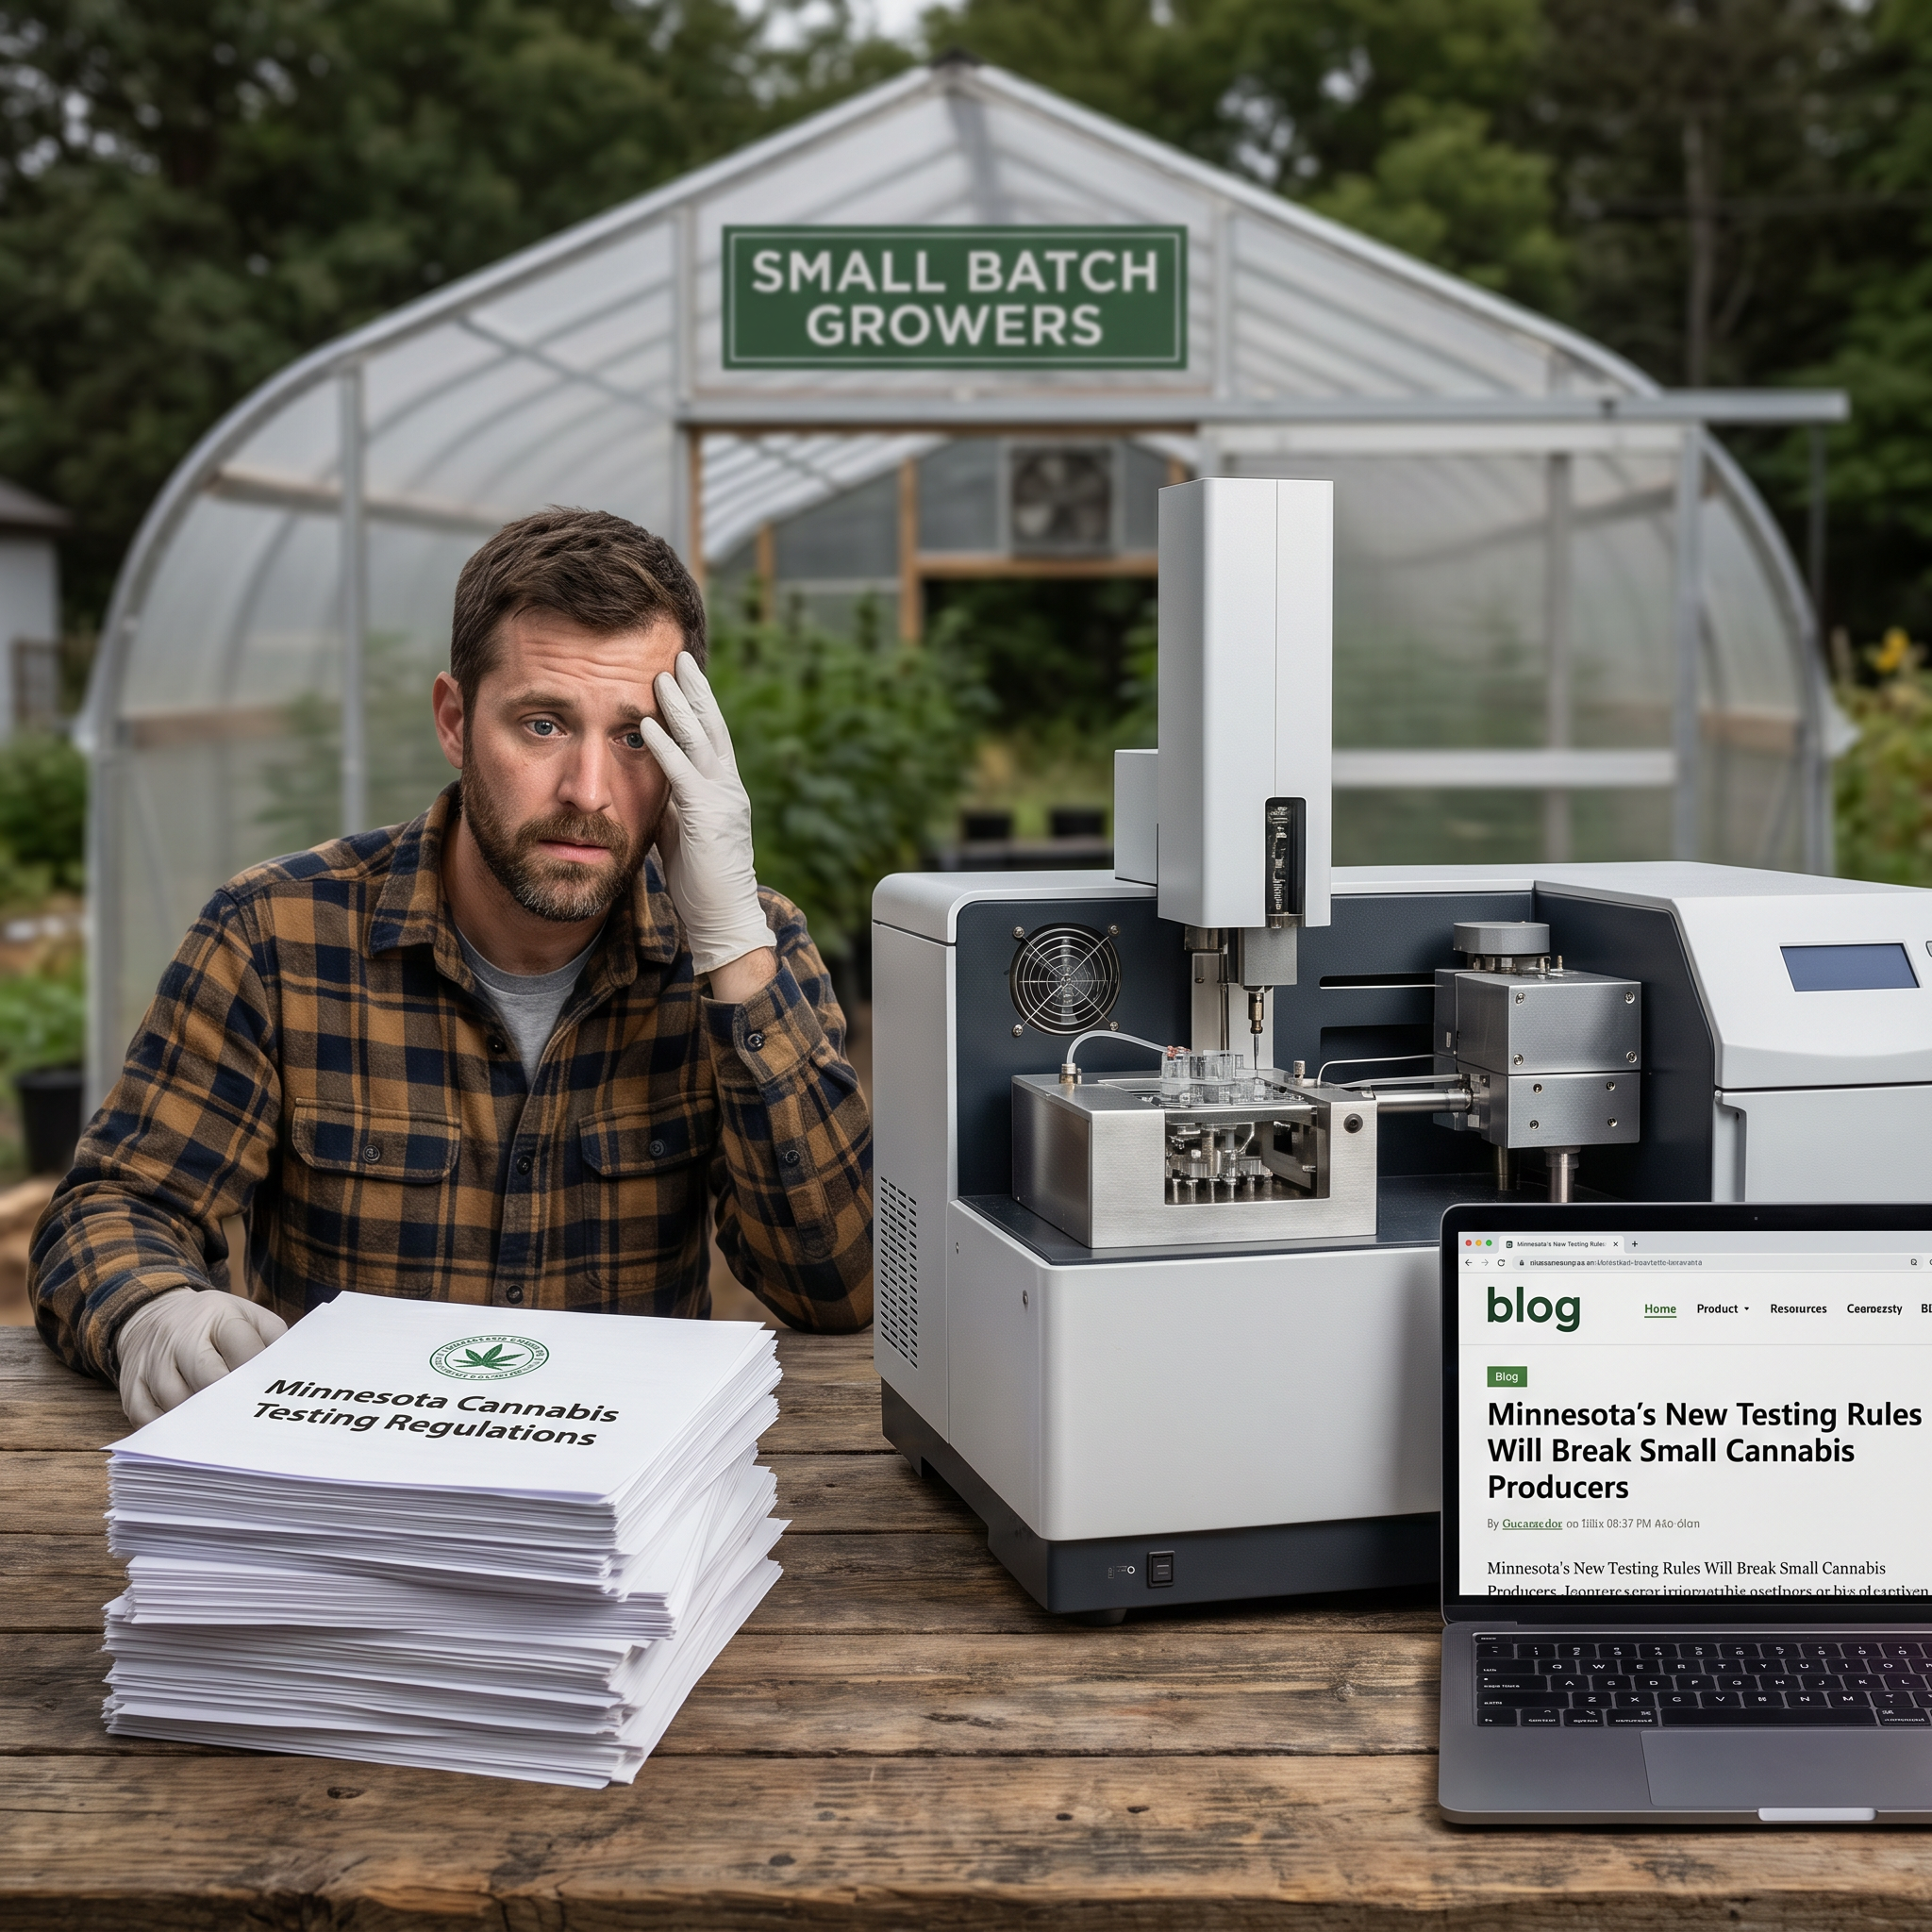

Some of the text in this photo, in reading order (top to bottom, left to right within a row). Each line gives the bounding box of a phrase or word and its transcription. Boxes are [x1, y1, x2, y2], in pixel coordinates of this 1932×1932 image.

[752, 249, 1158, 293] SMALL BATCH
[806, 304, 1103, 346] GROWERS
[1487, 1286, 1581, 1333] blog
[1644, 1303, 1677, 1314] Home
[1697, 1303, 1739, 1314] Product
[1495, 1372, 1519, 1384] Blog
[263, 1378, 621, 1424] Minnesota Cannabis
[251, 1401, 599, 1447] Testing Regulations
[1489, 1401, 1923, 1434] Minnesota’s New Testing Rules
[1487, 1437, 1855, 1463] Will Break Small Cannabis
[1489, 1474, 1629, 1499] Producers
[1487, 1518, 1500, 1532] By
[1607, 1518, 1634, 1529] 08:37
[1636, 1518, 1652, 1528] PM
[1487, 1560, 1887, 1578] Minnesota's New Testing Rules Will Break Small Cannabis
